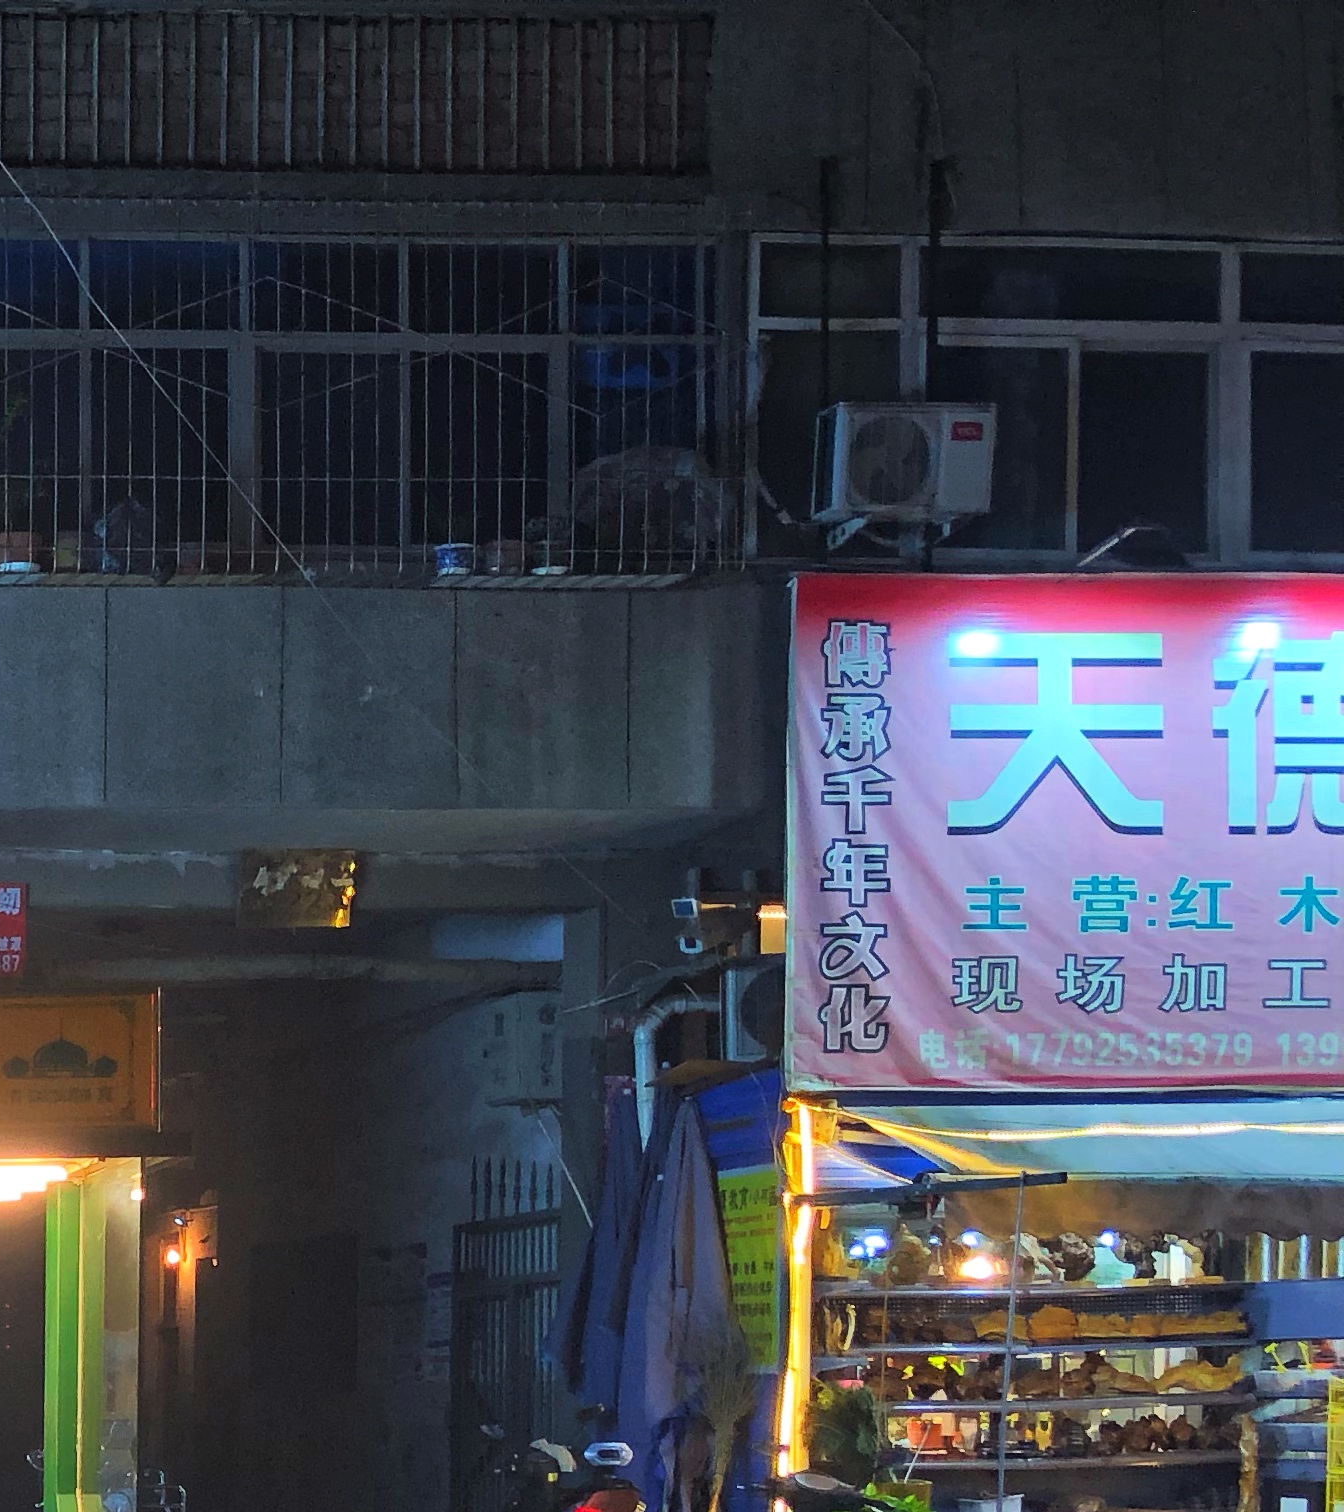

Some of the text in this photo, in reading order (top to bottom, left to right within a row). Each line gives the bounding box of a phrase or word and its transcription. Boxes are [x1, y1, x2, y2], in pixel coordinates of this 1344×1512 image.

[819, 619, 895, 1054] 傳承千年文化
[951, 953, 1330, 1014] 现场加工
